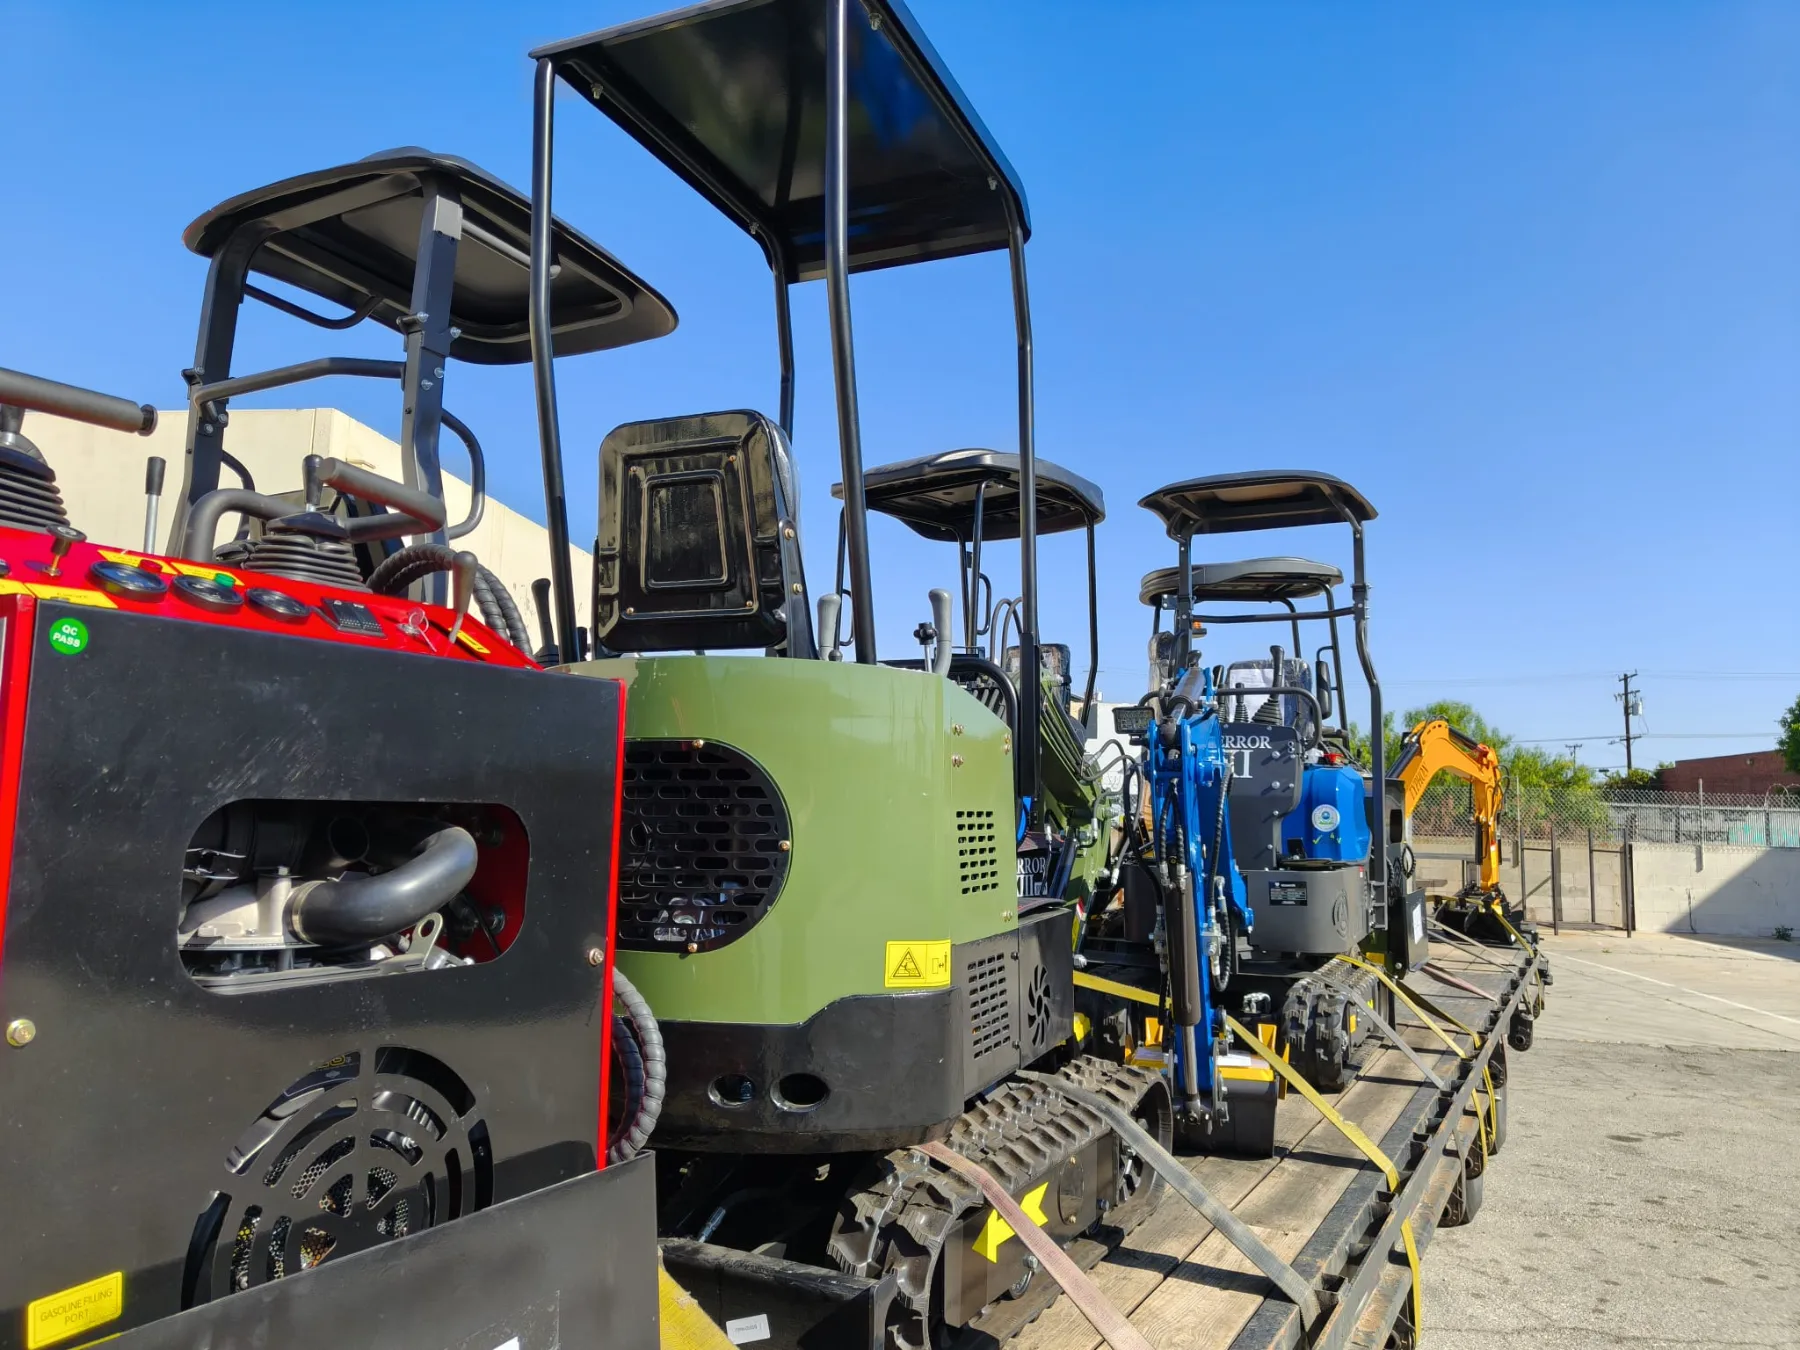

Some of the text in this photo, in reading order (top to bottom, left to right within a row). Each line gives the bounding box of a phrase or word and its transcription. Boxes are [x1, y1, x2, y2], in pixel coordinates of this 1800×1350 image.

[62, 625, 78, 636] QC
[53, 632, 80, 648] PASS
[1017, 857, 1046, 874] RROR
[40, 1287, 113, 1322] GASOLINE FILLING
[64, 1309, 89, 1325] PORT
